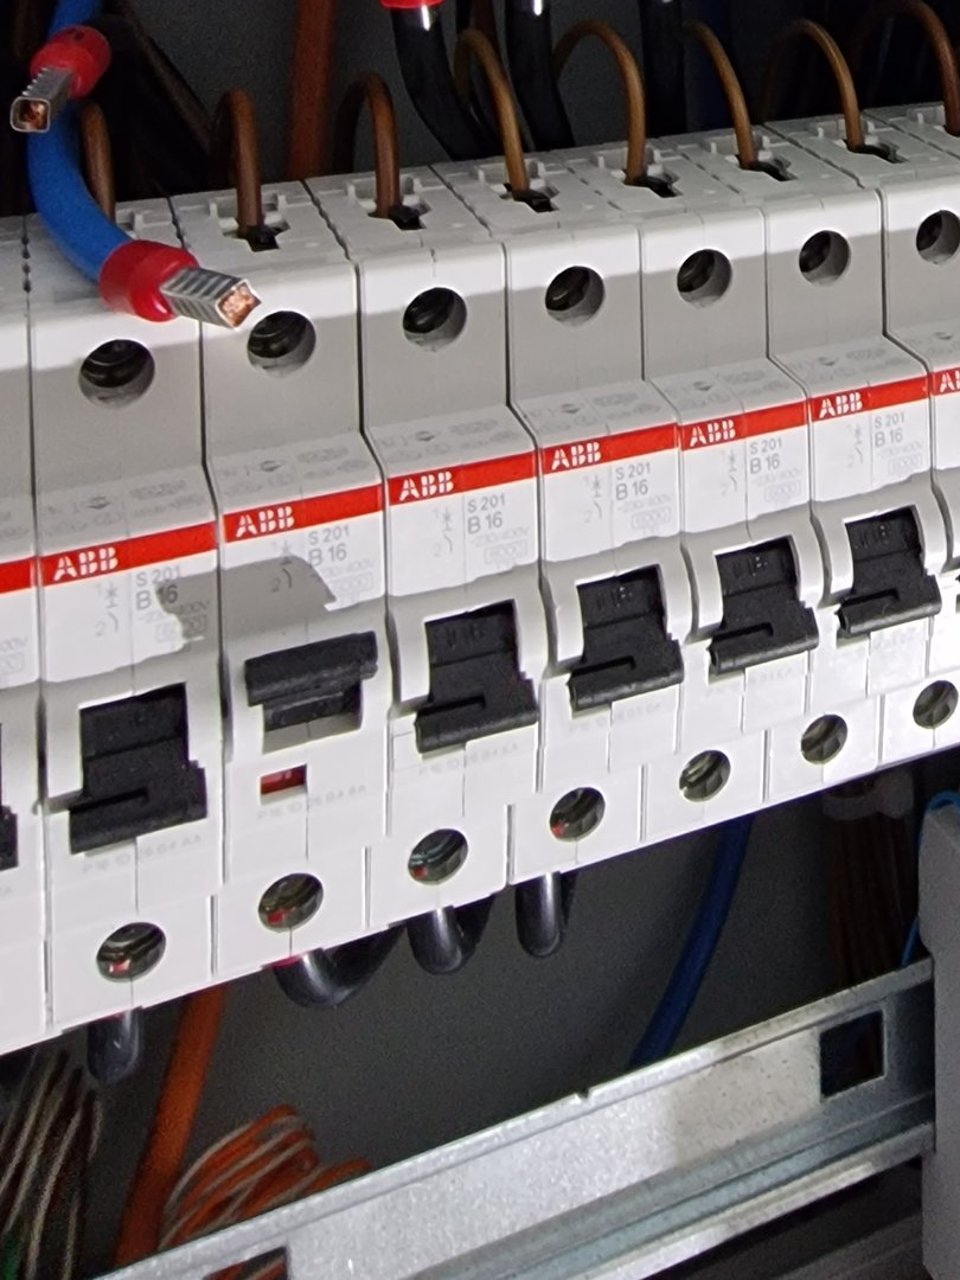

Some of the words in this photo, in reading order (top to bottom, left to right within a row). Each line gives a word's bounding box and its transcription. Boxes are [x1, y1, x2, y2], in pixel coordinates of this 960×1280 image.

[819, 392, 862, 418] ABB
[886, 412, 905, 427] 201
[690, 419, 736, 447] ABB
[875, 431, 885, 447] B
[890, 427, 903, 444] 16
[551, 441, 601, 470] ABB
[750, 442, 758, 455] S
[761, 438, 782, 453] 201
[615, 467, 624, 480] S
[628, 462, 651, 478] 201
[750, 458, 761, 474] B
[766, 453, 780, 471] 16
[399, 471, 454, 501] ABB
[616, 483, 628, 501] B
[632, 479, 648, 496] 16
[467, 500, 477, 513] S
[481, 494, 505, 510] 201
[236, 506, 294, 537] ABB
[467, 517, 481, 534] B
[485, 512, 503, 529] 16
[308, 532, 318, 545] S
[323, 525, 350, 542] 201
[53, 547, 119, 581] ABB
[308, 549, 323, 566] B
[328, 543, 347, 562] 16
[136, 572, 148, 587] S
[152, 566, 181, 584] 201
[136, 591, 150, 610] B
[157, 584, 178, 604] 16
